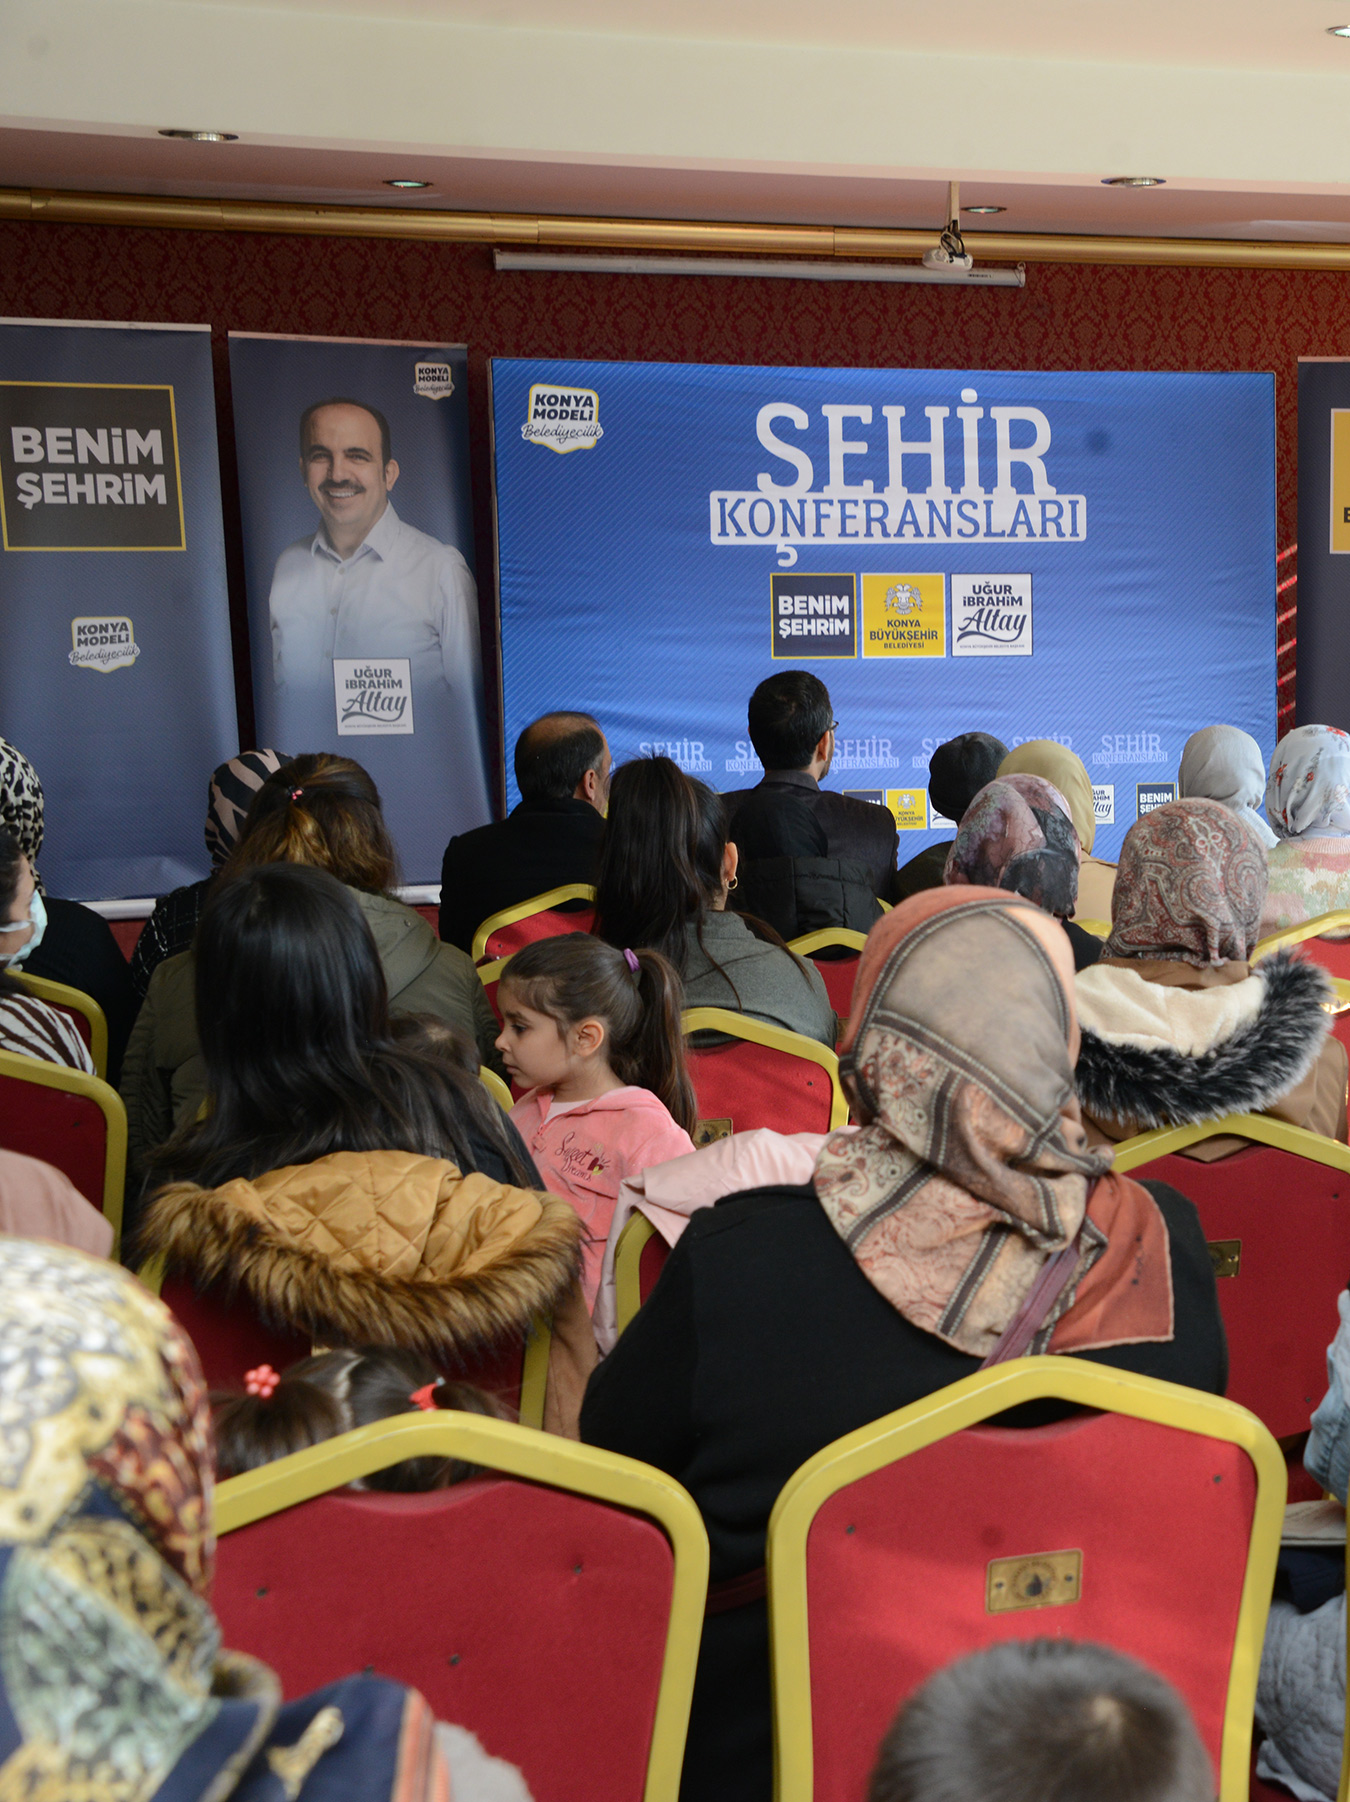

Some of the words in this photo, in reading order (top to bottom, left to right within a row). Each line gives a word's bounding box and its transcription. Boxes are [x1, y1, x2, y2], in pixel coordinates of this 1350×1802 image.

[535, 394, 594, 407] KONYA
[523, 423, 602, 445] Belediyecilik
[717, 498, 1080, 538] KONFERANSLARI
[972, 581, 1013, 595] UĞUR
[77, 622, 129, 636] KONYA
[886, 619, 921, 628] KONYA
[957, 607, 1028, 643] Altay
[869, 628, 938, 641] BÜYÜKŞEHİR
[883, 641, 925, 649] BELEDİYESİ
[70, 645, 138, 665] Belediyecilik
[353, 665, 392, 679] UĞUR
[341, 690, 408, 723] Altay
[554, 1131, 593, 1166] Sweet
